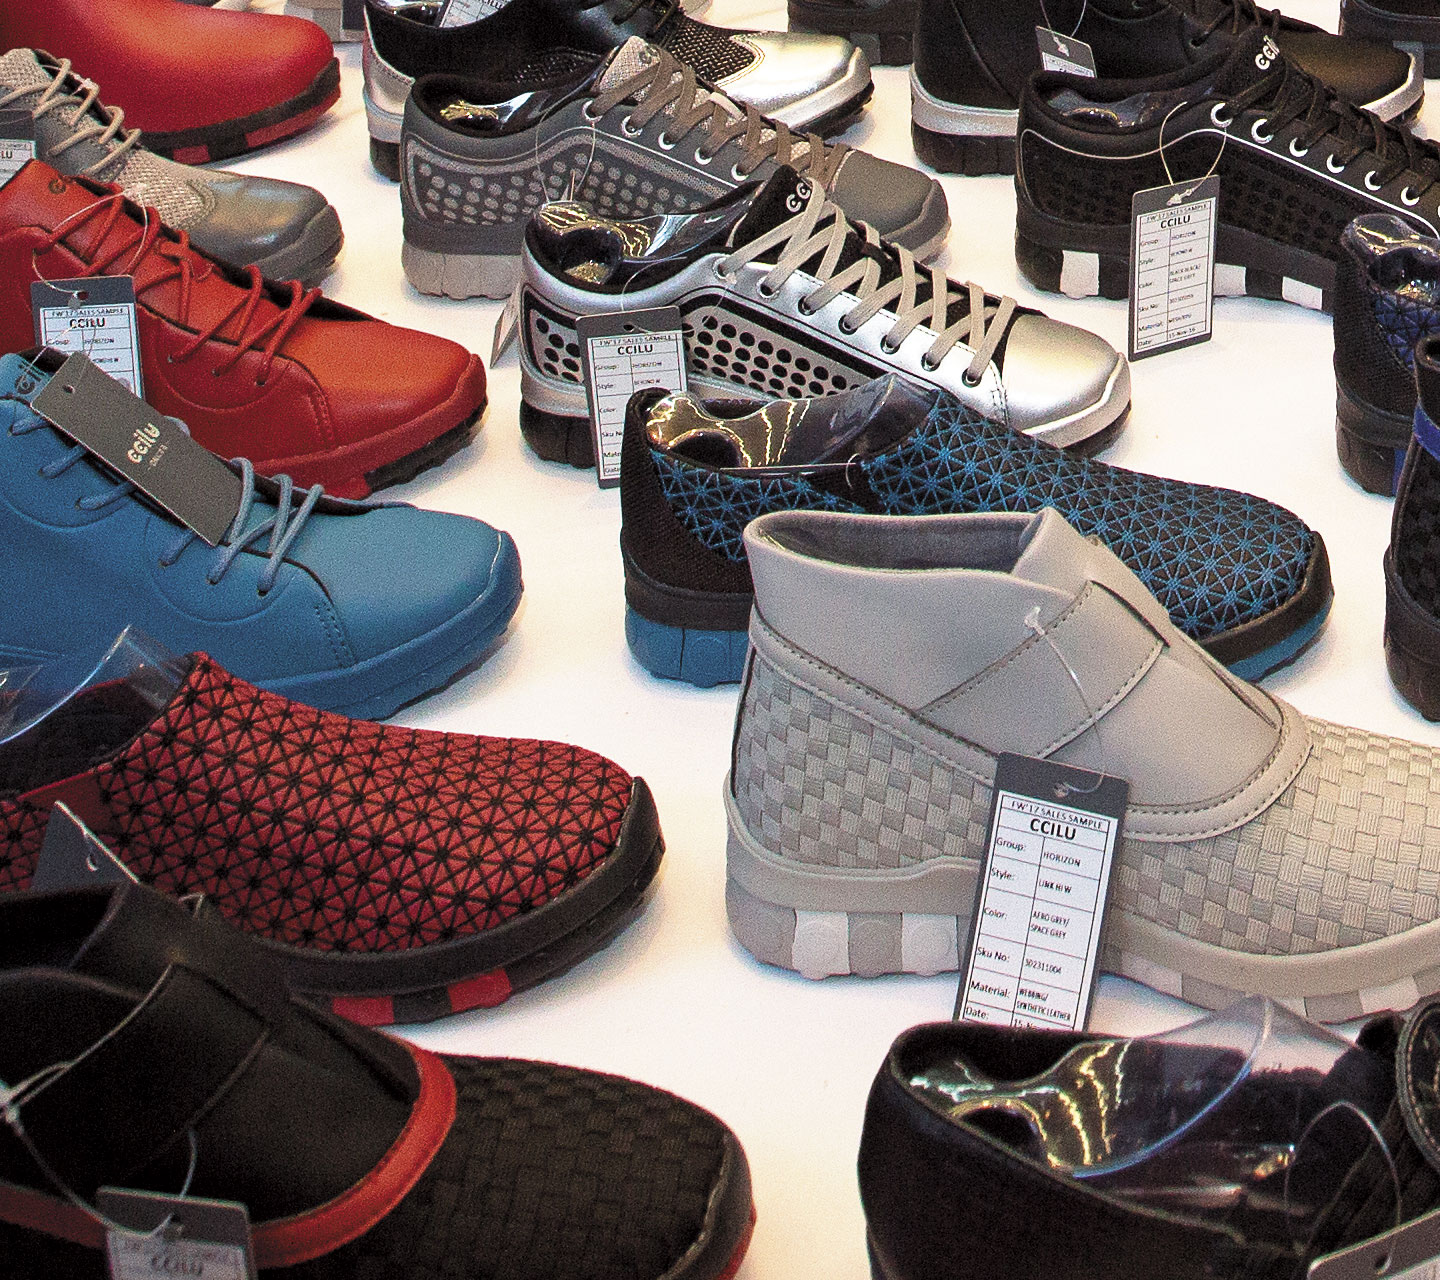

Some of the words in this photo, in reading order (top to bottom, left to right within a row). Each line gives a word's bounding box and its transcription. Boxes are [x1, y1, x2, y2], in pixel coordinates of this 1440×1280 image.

[1161, 214, 1189, 228] CCILU
[69, 317, 106, 329] CCILU
[618, 344, 652, 355] CCILU
[126, 422, 161, 464] ccilu
[1041, 808, 1067, 821] SALES
[1069, 815, 1101, 829] SAMPLE
[1030, 817, 1075, 840] CCILU
[996, 836, 1026, 852] Group:
[1043, 851, 1080, 866] HORIZON
[990, 868, 1015, 881] Style:
[983, 907, 1007, 919] Color:
[976, 946, 992, 958] Sku
[993, 950, 1010, 962] No:
[971, 981, 1010, 998] Material:
[965, 1006, 989, 1019] Date:
